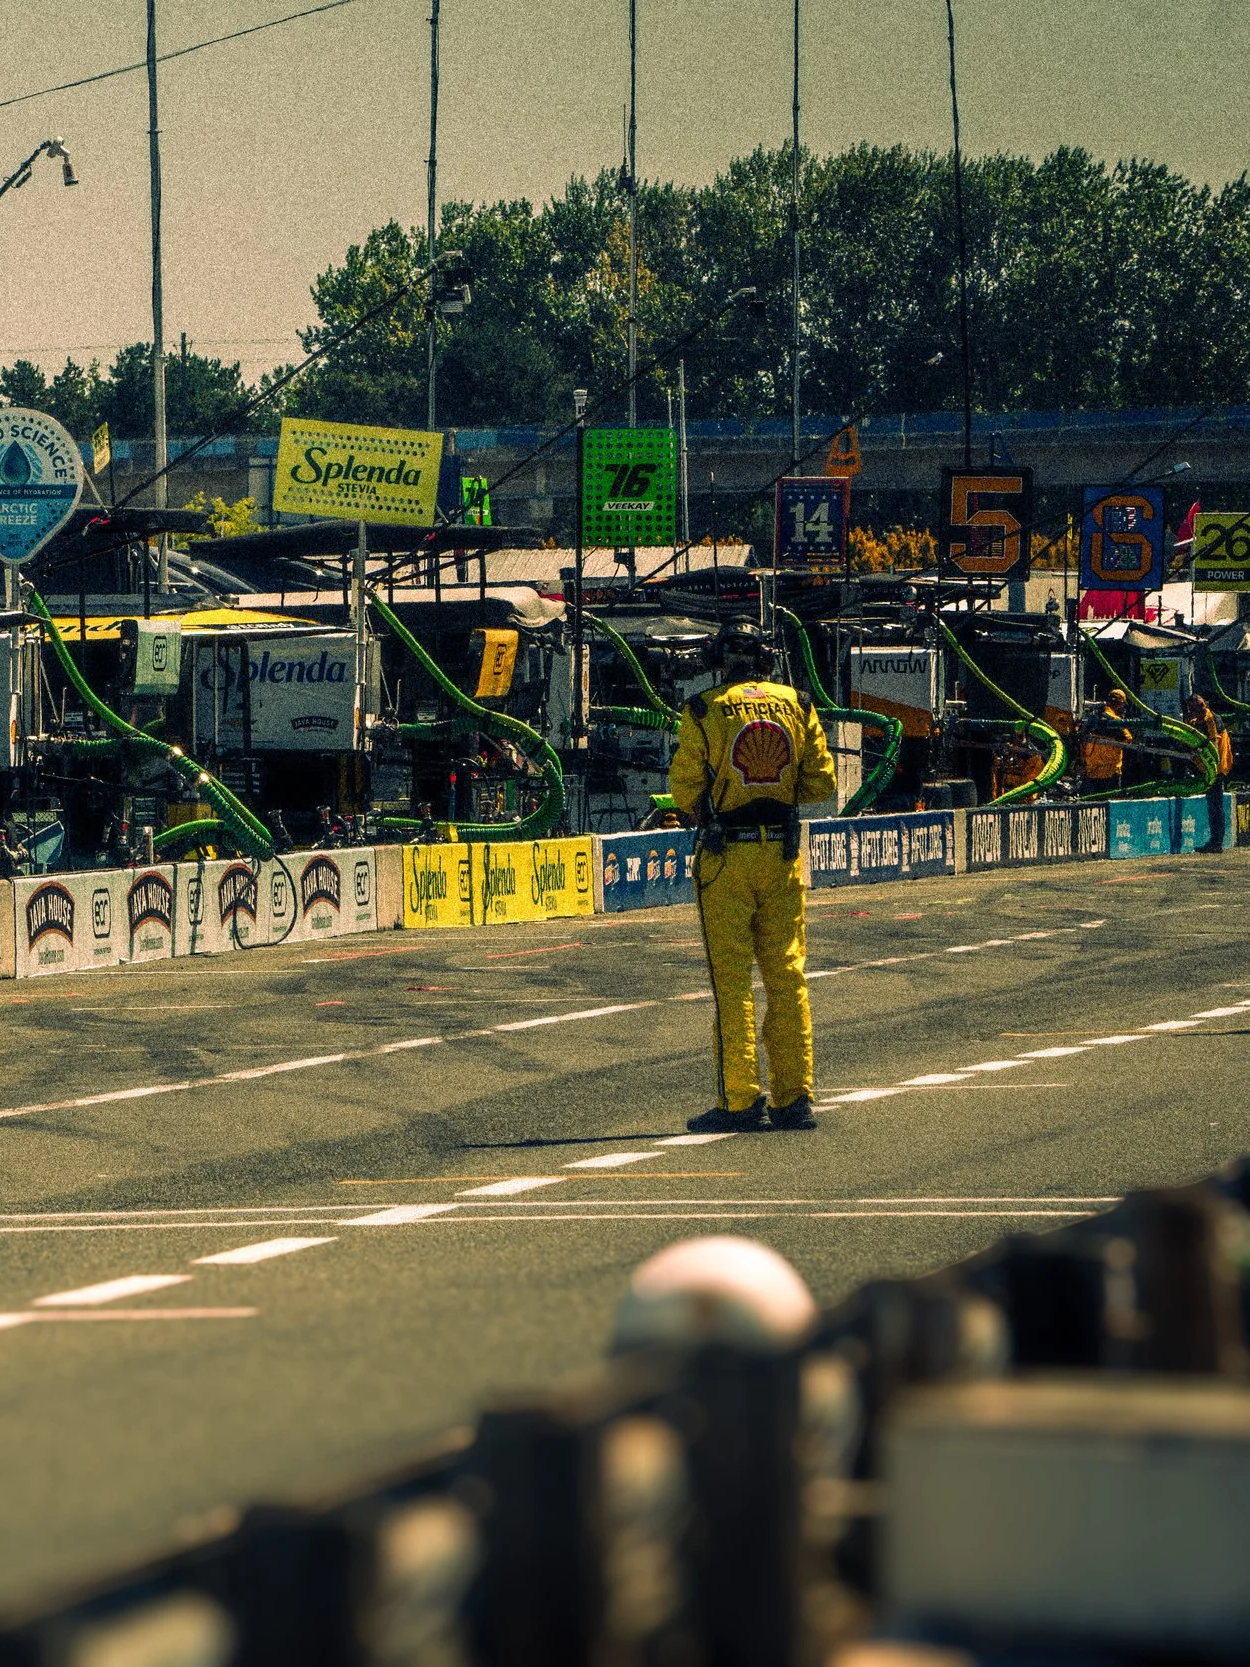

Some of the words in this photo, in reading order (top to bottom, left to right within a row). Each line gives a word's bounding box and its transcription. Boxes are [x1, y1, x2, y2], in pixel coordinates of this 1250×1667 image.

[10, 424, 68, 479] SCIENCE
[290, 446, 422, 487] Splenda
[338, 483, 377, 495] STEVIA
[604, 463, 657, 498] 76
[607, 502, 651, 510] VEEKAY
[789, 501, 834, 543] 14
[950, 476, 1023, 573] 5
[1200, 522, 1250, 562] 26
[1207, 570, 1245, 580] POWER
[859, 658, 928, 674] ARROW
[721, 701, 791, 718] OFFICIAL
[303, 868, 317, 905] JAVA
[317, 865, 339, 902] HOUSE
[410, 845, 447, 916] Splenda
[481, 844, 516, 913] Splenda
[531, 841, 566, 907] Splenda
[30, 896, 47, 937] JAVA
[47, 893, 73, 934] HOUSE
[147, 882, 171, 920] HOUSE
[220, 876, 234, 915] JAVA
